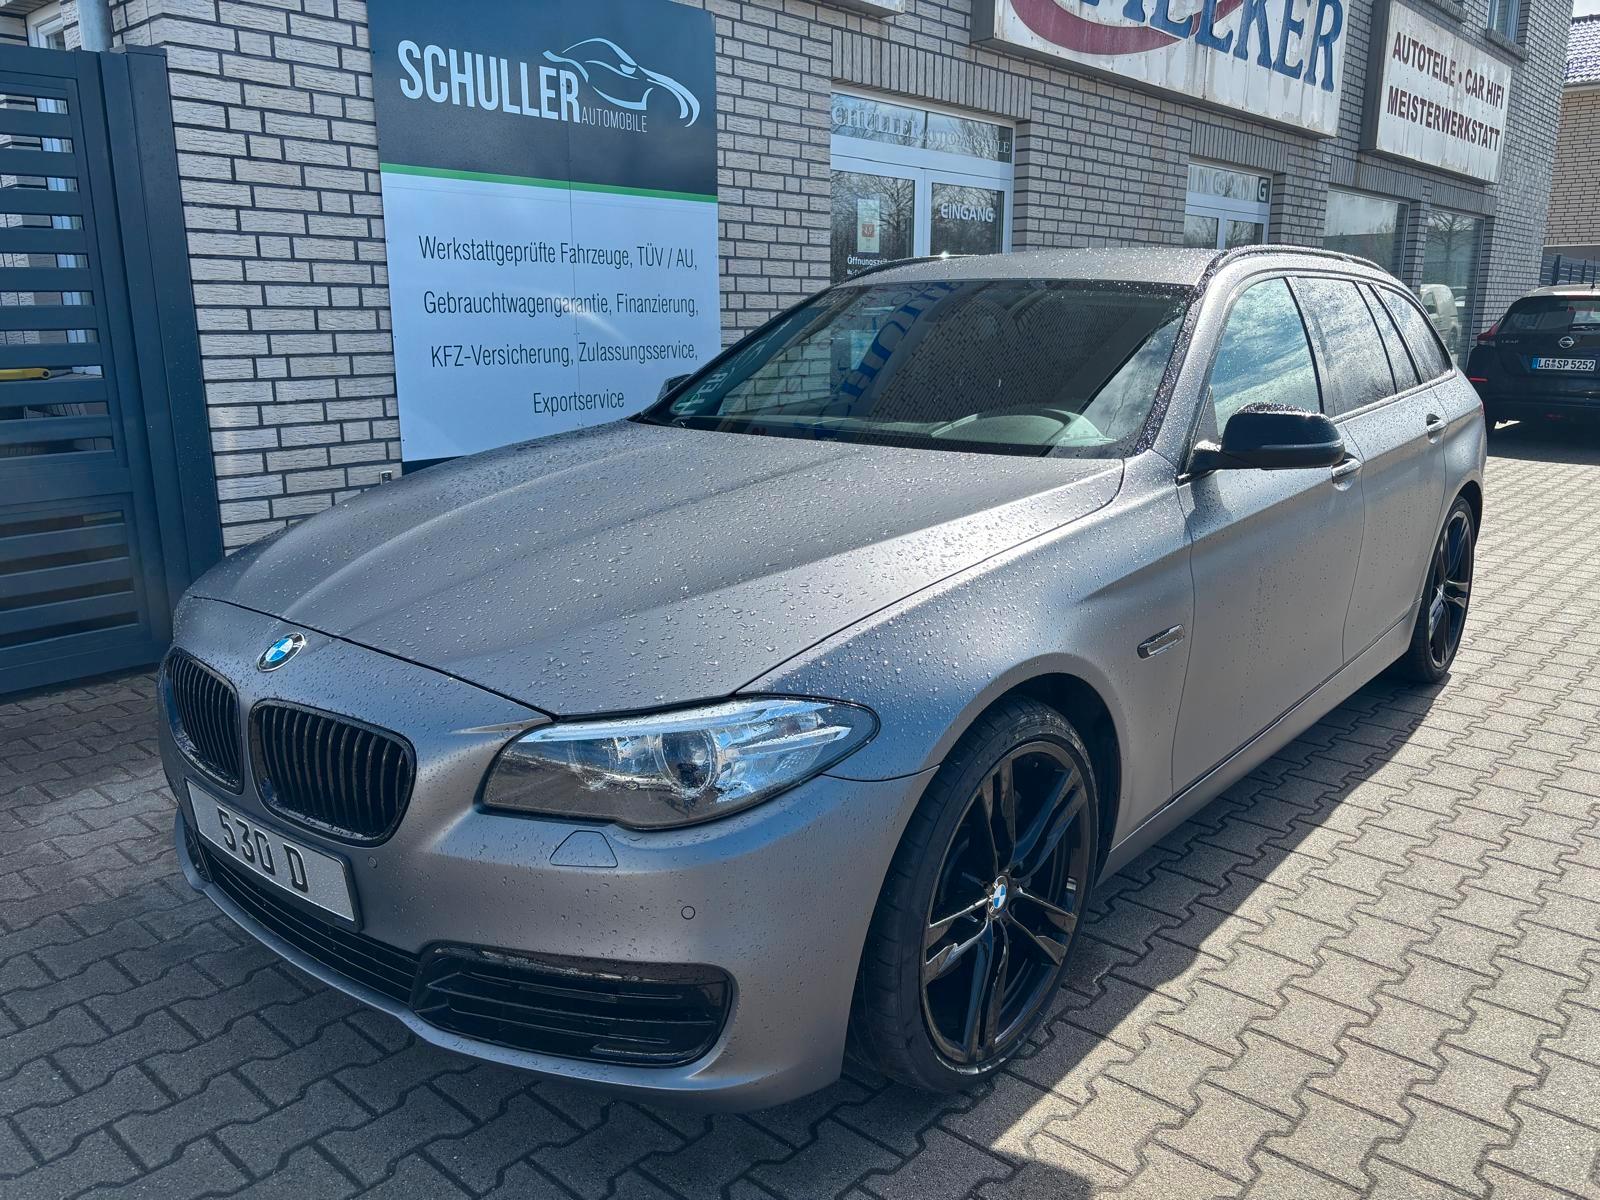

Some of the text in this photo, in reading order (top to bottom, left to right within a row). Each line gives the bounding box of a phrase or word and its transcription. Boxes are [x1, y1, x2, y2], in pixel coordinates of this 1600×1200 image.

[1392, 31, 1505, 110] AUTOTEILE CAR HIFI
[397, 40, 648, 133] SCHULLER AUTOMOBILE
[1387, 85, 1500, 152] MEISTERWERKSTATT
[941, 202, 994, 223] EINGANG
[419, 235, 556, 266] Werkstattgeprüfte
[561, 242, 633, 270] Fahrzeuge,
[636, 243, 663, 267] TÜV
[676, 247, 698, 271] AU,
[423, 291, 699, 317] Gebrauchtwagengarantie, Finanzierung,
[430, 341, 698, 368] KFZ-Versicherung, Zulassungsservice,
[1538, 359, 1595, 370] LG SP 5252
[533, 391, 625, 414] Exportservice
[217, 804, 309, 893] 530 D
